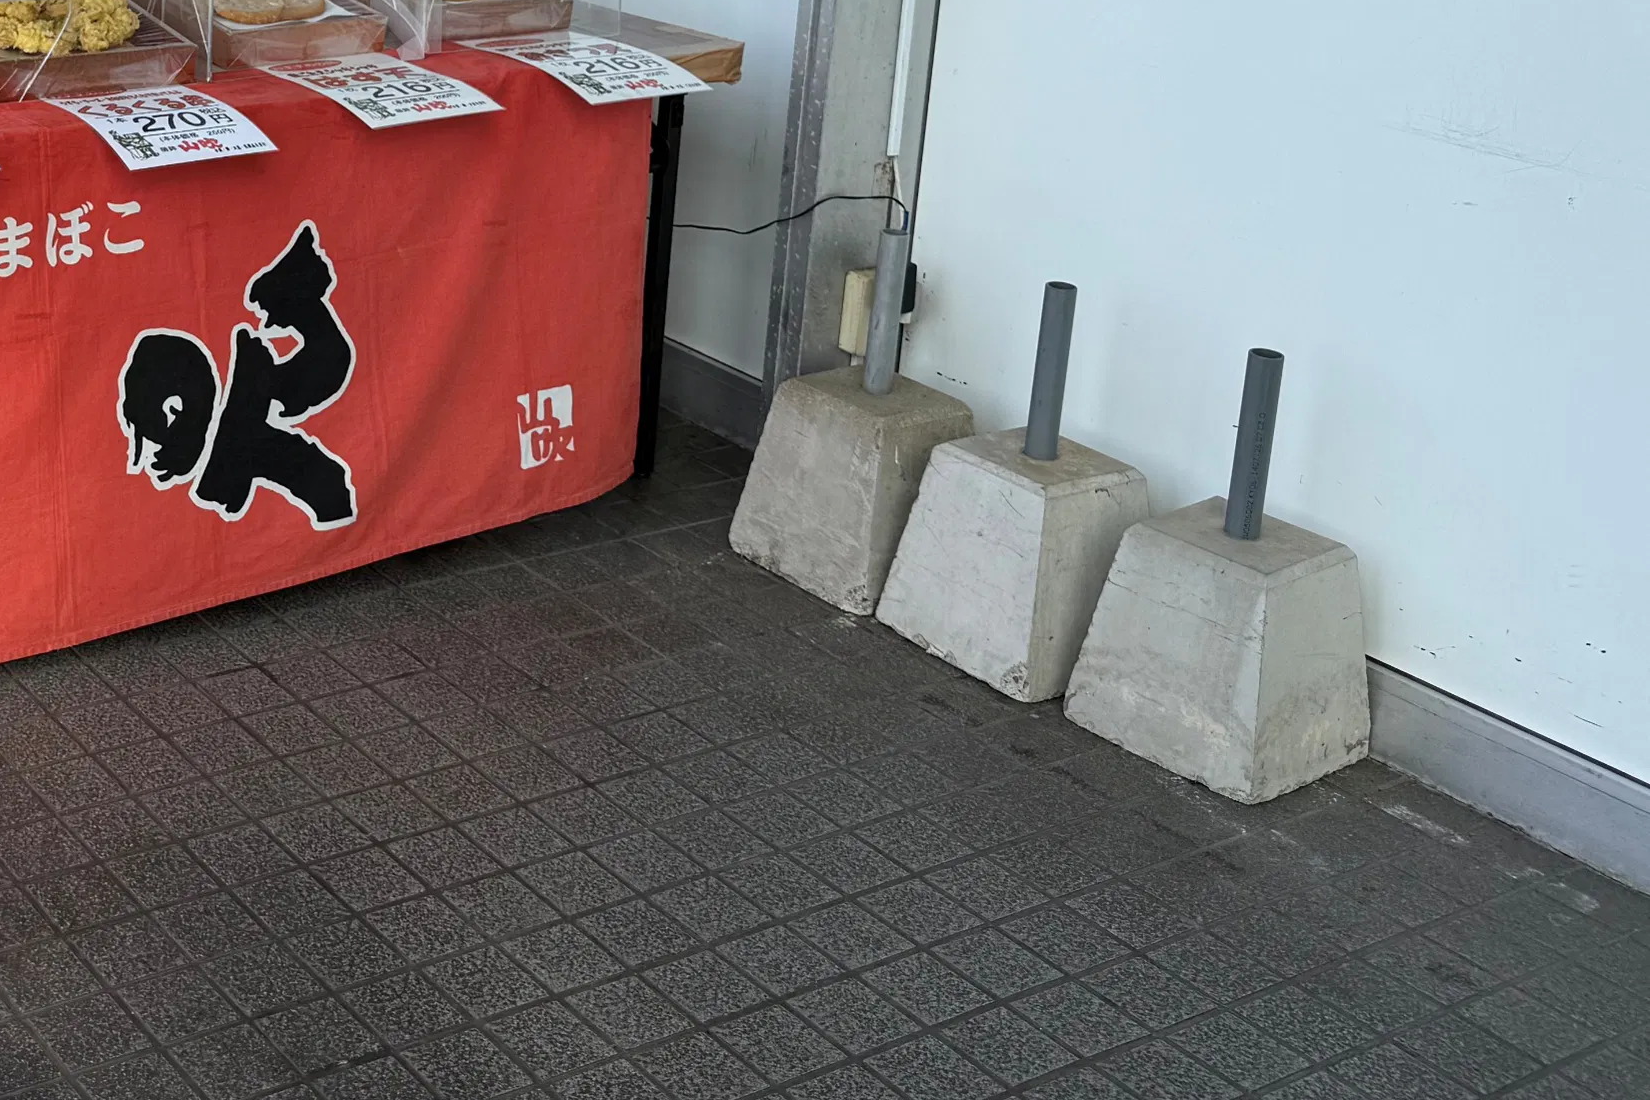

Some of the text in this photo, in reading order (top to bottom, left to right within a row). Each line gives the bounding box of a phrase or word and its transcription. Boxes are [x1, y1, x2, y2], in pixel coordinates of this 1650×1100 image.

[573, 56, 640, 75] 216
[362, 80, 433, 99] 216
[133, 111, 207, 133] 270
